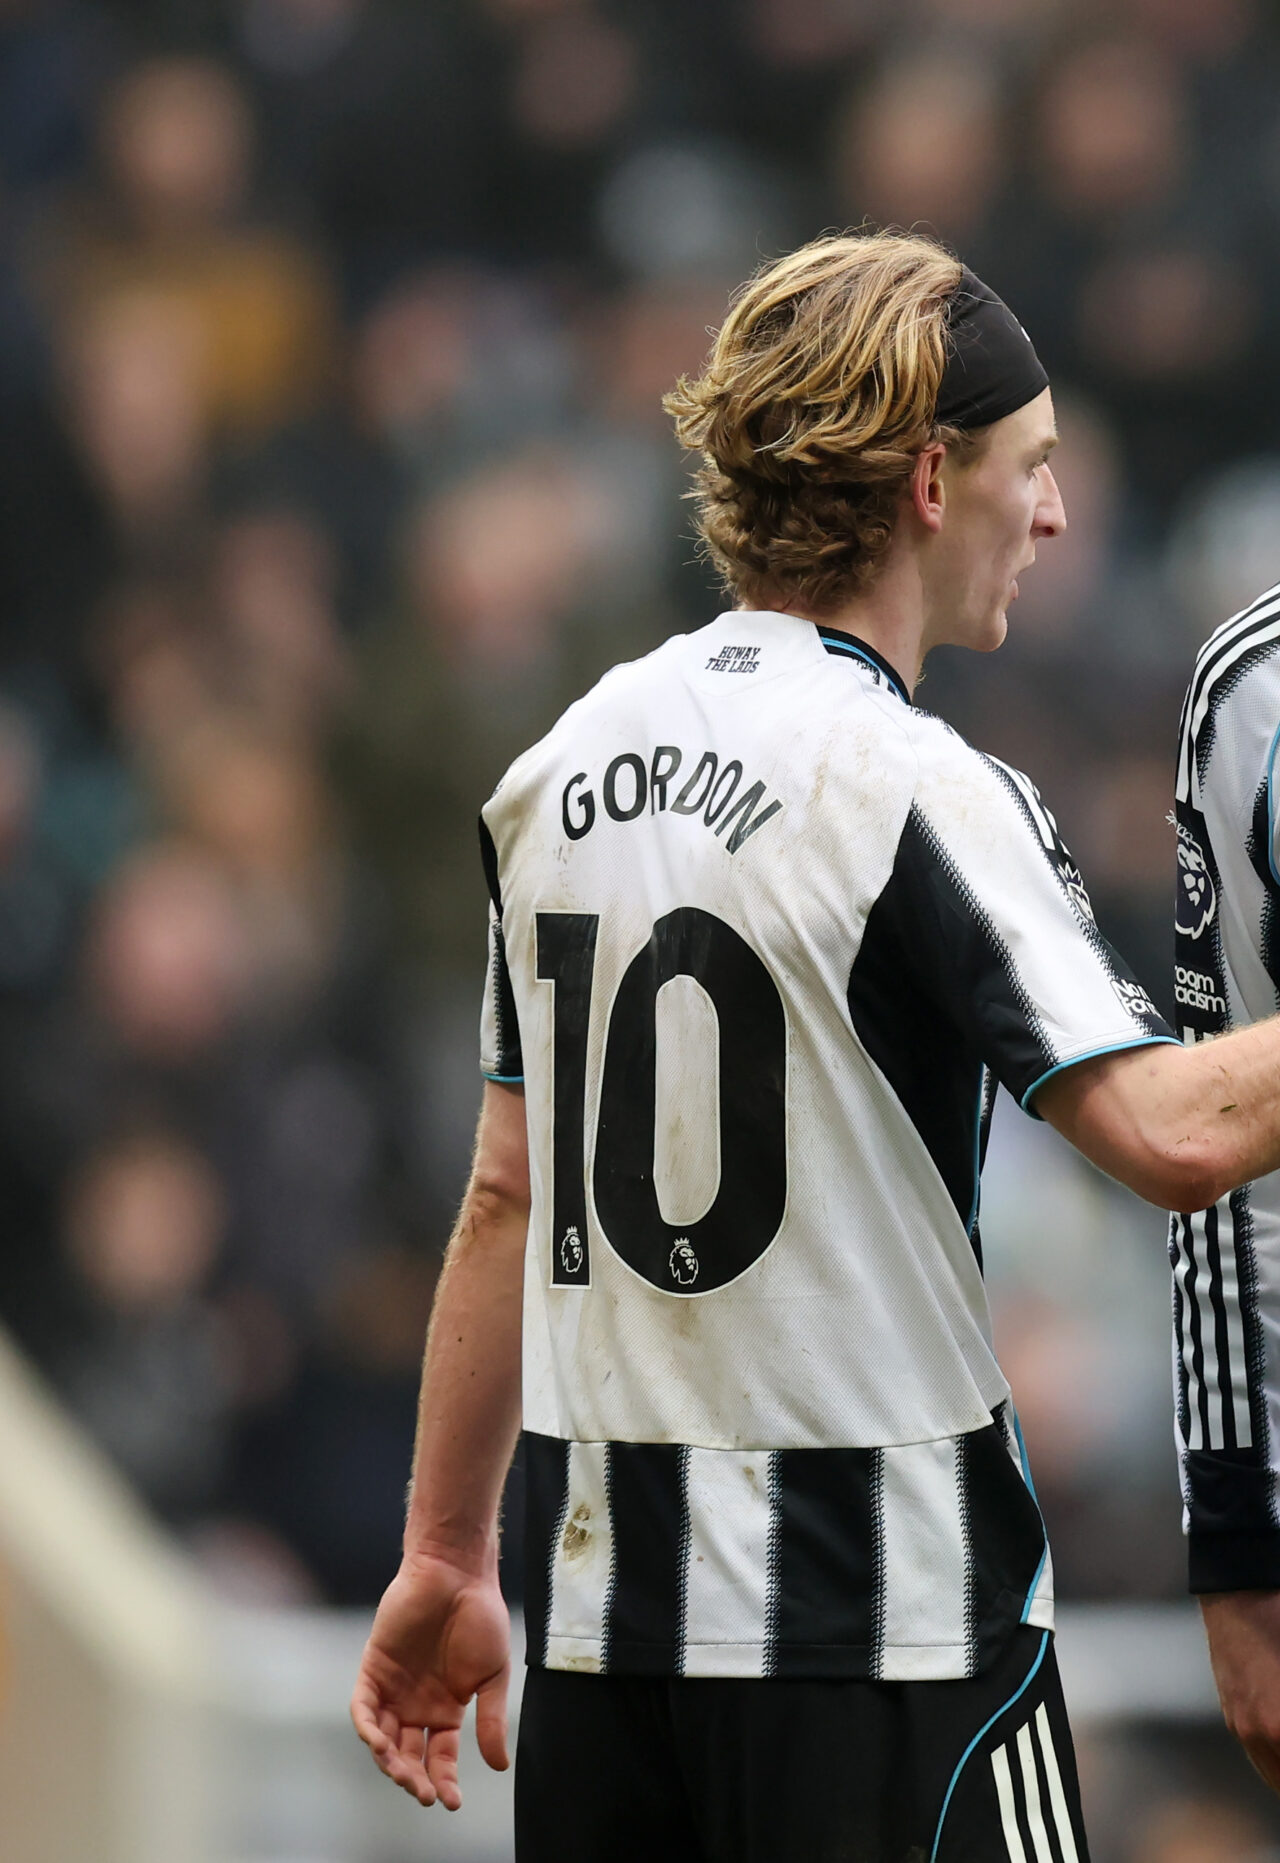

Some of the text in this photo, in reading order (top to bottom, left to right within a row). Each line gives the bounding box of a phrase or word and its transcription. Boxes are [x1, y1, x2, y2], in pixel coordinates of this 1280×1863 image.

[705, 657, 760, 673] THE LADS
[718, 645, 761, 660] HOWAY
[562, 746, 783, 856] GORDON
[1174, 965, 1215, 993] oom
[1174, 984, 1226, 1013] acism
[535, 906, 789, 1297] 10
